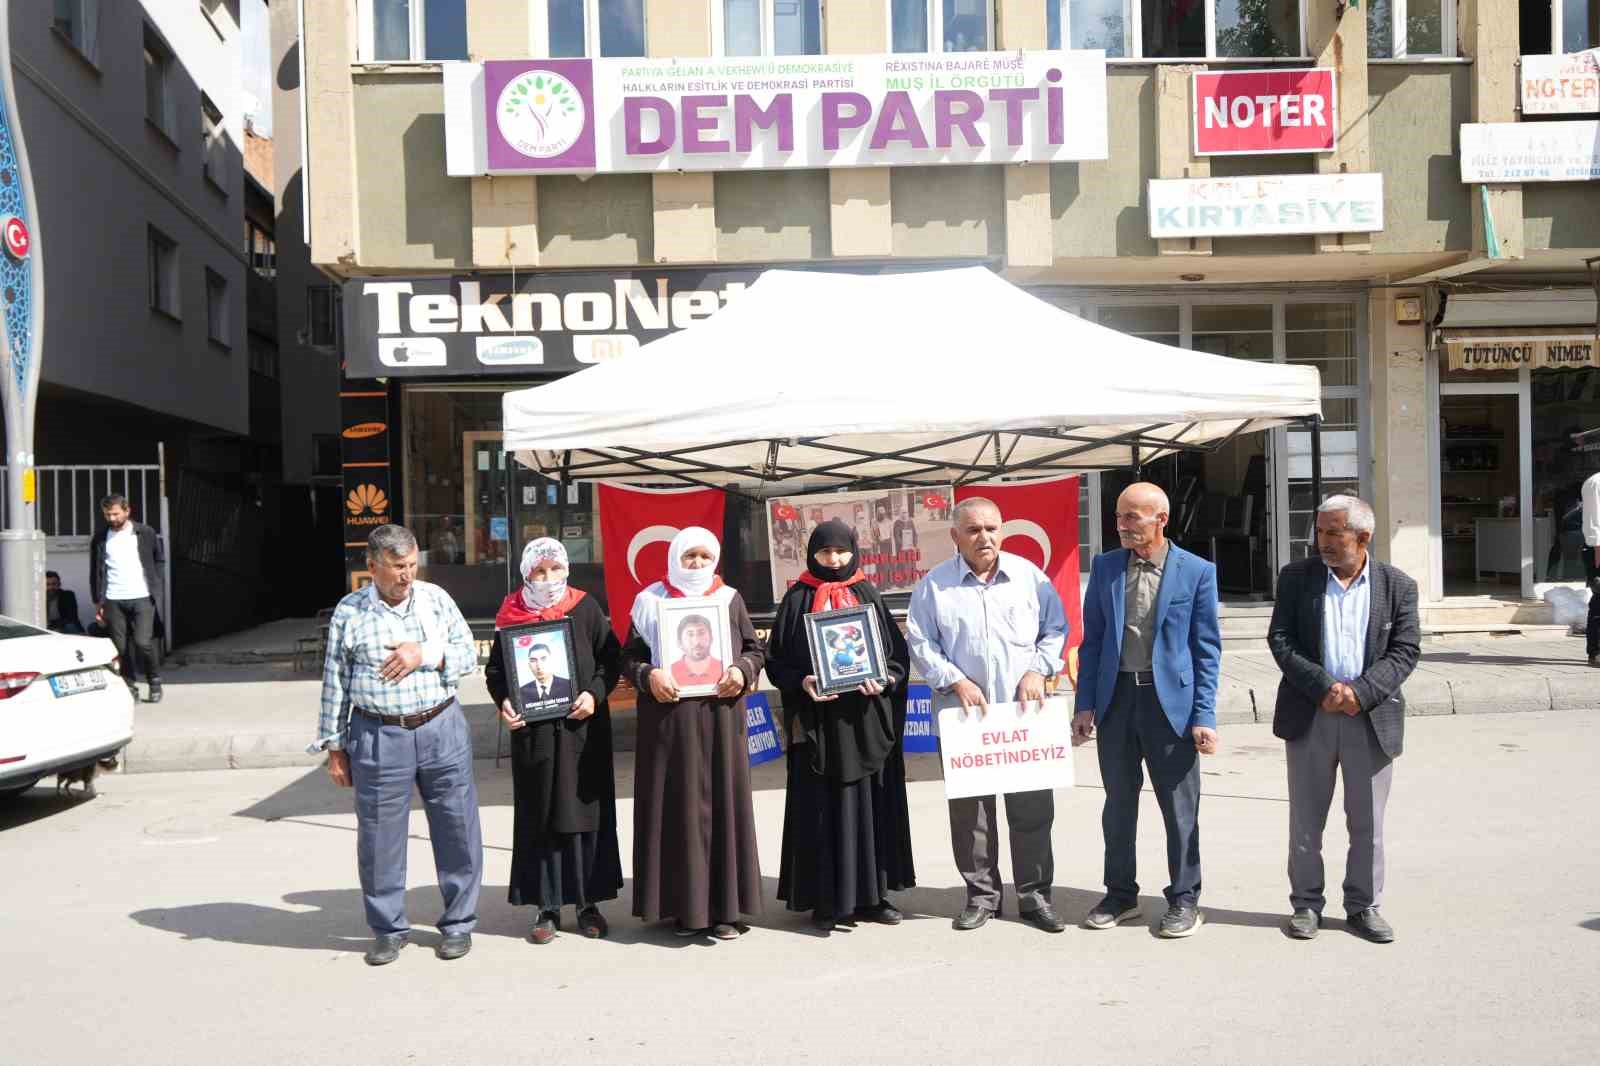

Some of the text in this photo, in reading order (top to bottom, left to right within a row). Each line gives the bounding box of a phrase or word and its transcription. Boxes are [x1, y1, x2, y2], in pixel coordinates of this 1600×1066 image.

[731, 80, 745, 91] VE
[886, 77, 924, 90] MUŞ
[930, 74, 945, 89] İL
[1525, 79, 1597, 98] NOTER
[623, 68, 1065, 156] DEM PARTİ
[1203, 94, 1327, 129] NOTER
[1157, 199, 1376, 229] KIRTASİYE
[1463, 341, 1592, 363] TÜTÜNCÜ NİMET
[347, 516, 390, 525] HUAWEI
[981, 729, 1029, 746] EVLAT
[950, 746, 1066, 770] NÖBETİNDEYİZ
